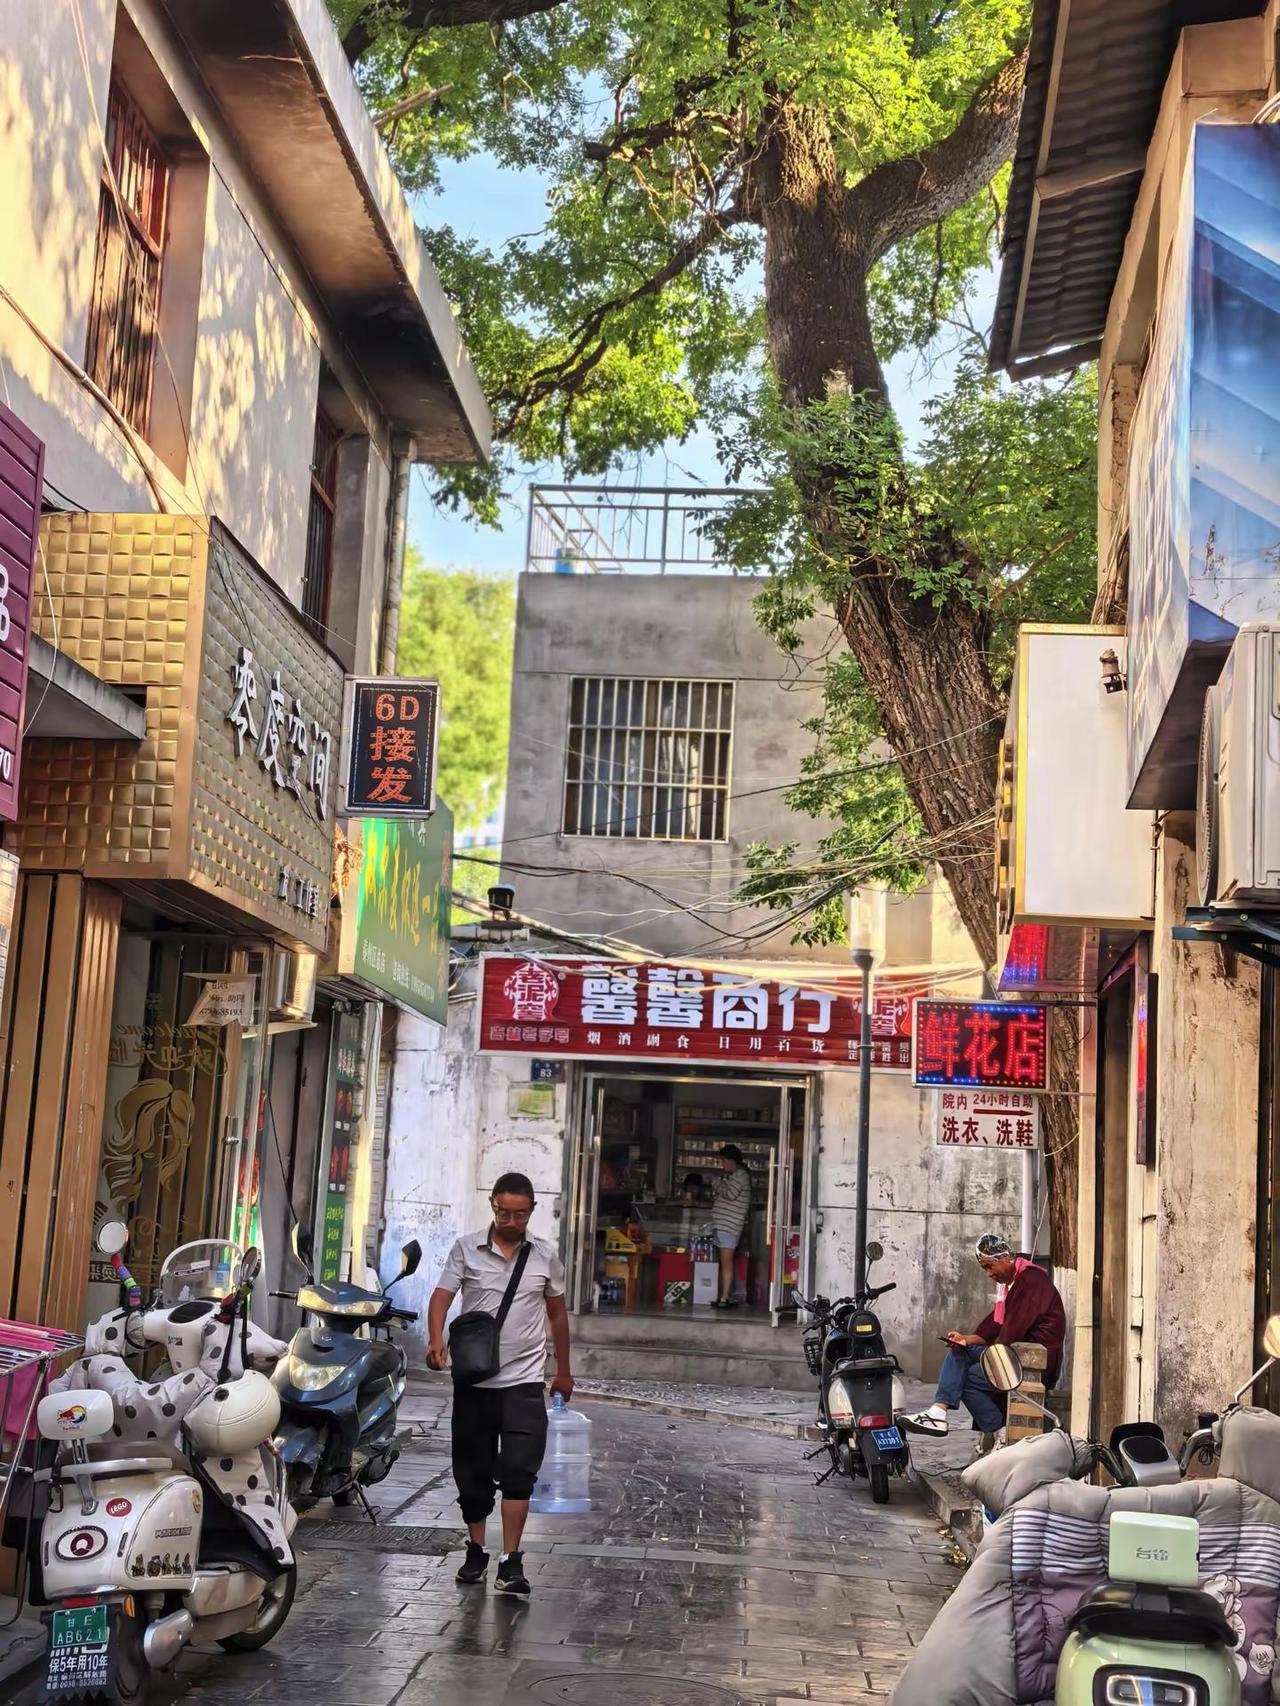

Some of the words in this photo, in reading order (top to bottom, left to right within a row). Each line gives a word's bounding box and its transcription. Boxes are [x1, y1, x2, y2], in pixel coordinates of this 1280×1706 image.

[375, 693, 420, 721] 6D
[367, 725, 417, 803] 接发
[581, 965, 837, 1033] 馨馨商行
[587, 1031, 690, 1049] 烟酒副食
[719, 1036, 825, 1053] 日用百货
[924, 1011, 1041, 1080] 鲜花店
[942, 1093, 968, 1110] 院内
[973, 1092, 1034, 1109] 24小时自助
[942, 1116, 1034, 1147] 洗衣、洗鞋
[110, 1501, 128, 1514] LEGO
[49, 1654, 108, 1674] 保5年用10年
